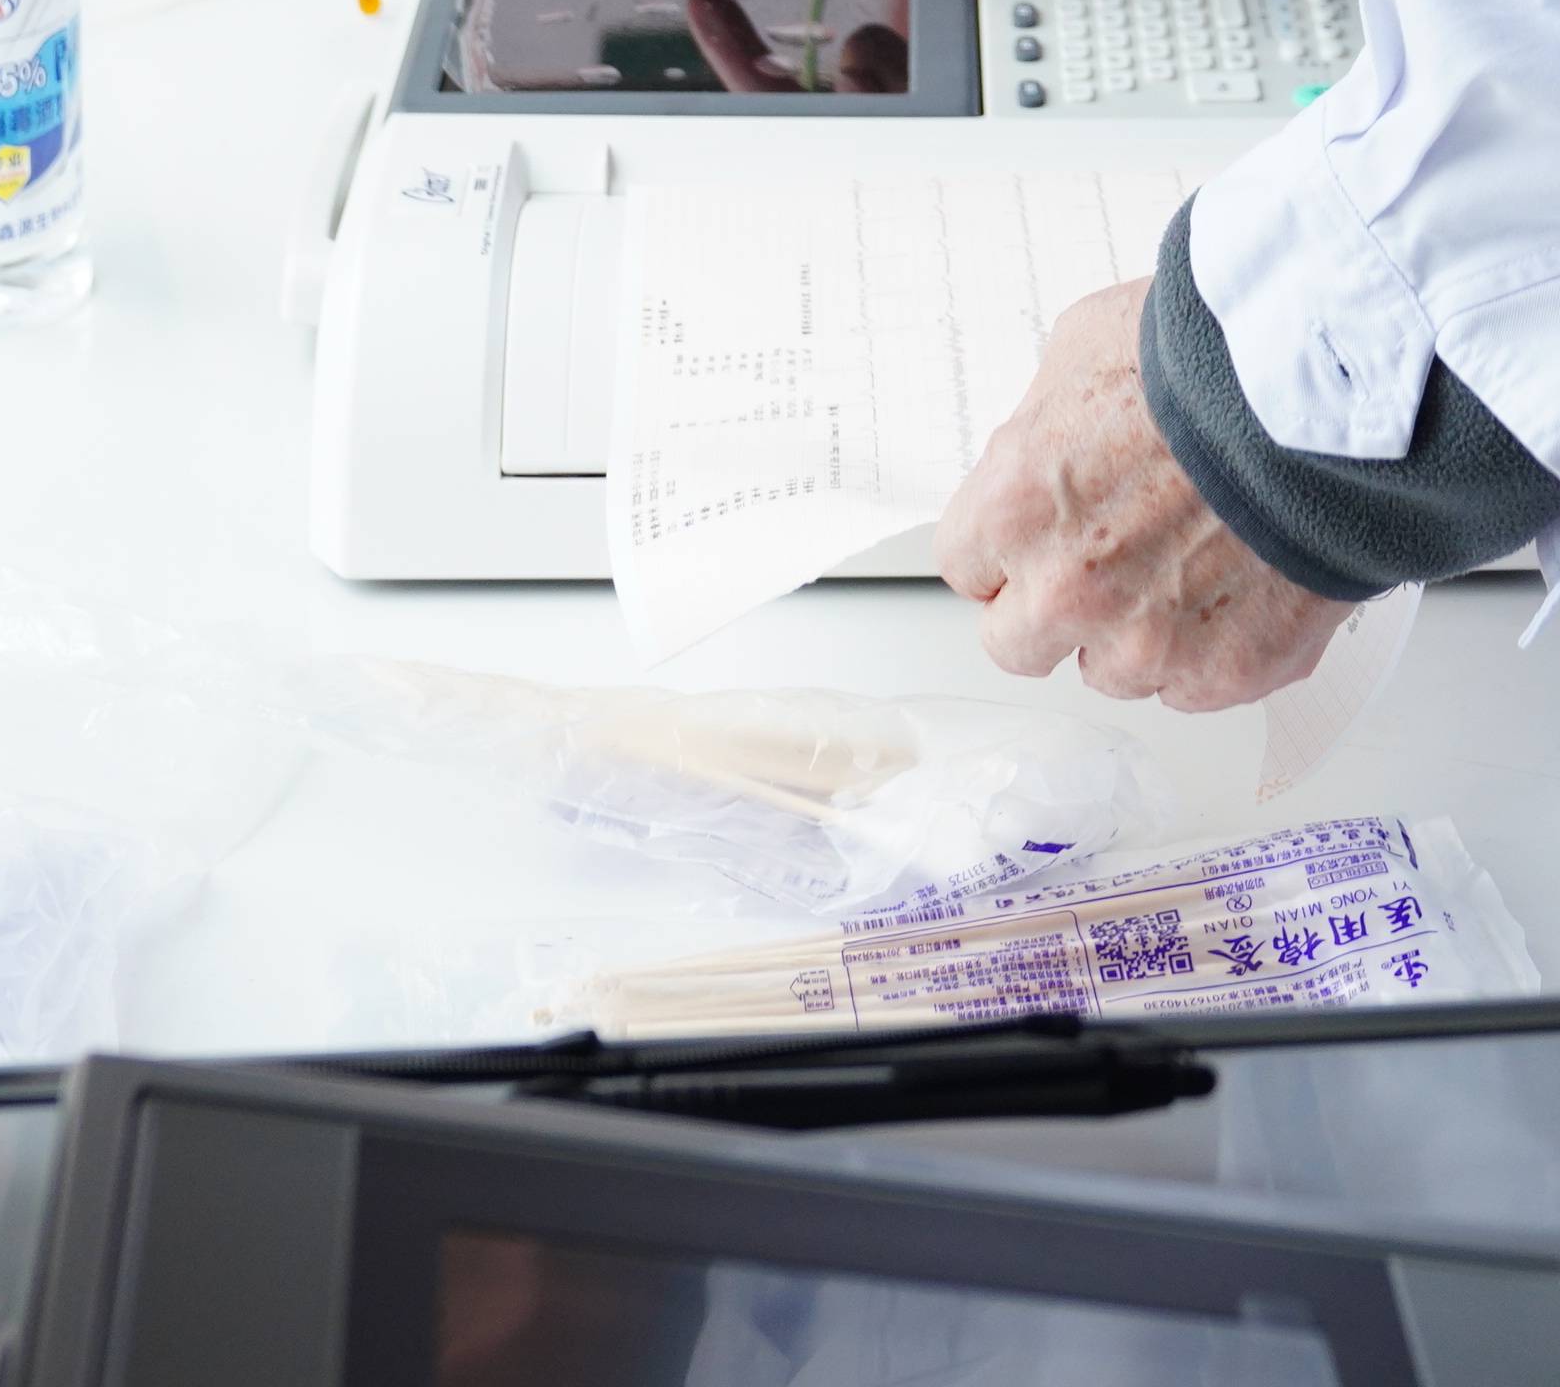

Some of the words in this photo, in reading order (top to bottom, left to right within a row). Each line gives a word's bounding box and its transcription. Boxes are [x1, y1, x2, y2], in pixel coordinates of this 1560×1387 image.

[1205, 878, 1265, 901] 切勿再次使用
[1330, 886, 1378, 910] YONG
[1393, 880, 1413, 893] YI
[1274, 901, 1322, 924] MIAN
[1204, 916, 1253, 935] QIAN
[1208, 895, 1423, 976] 医用棉签
